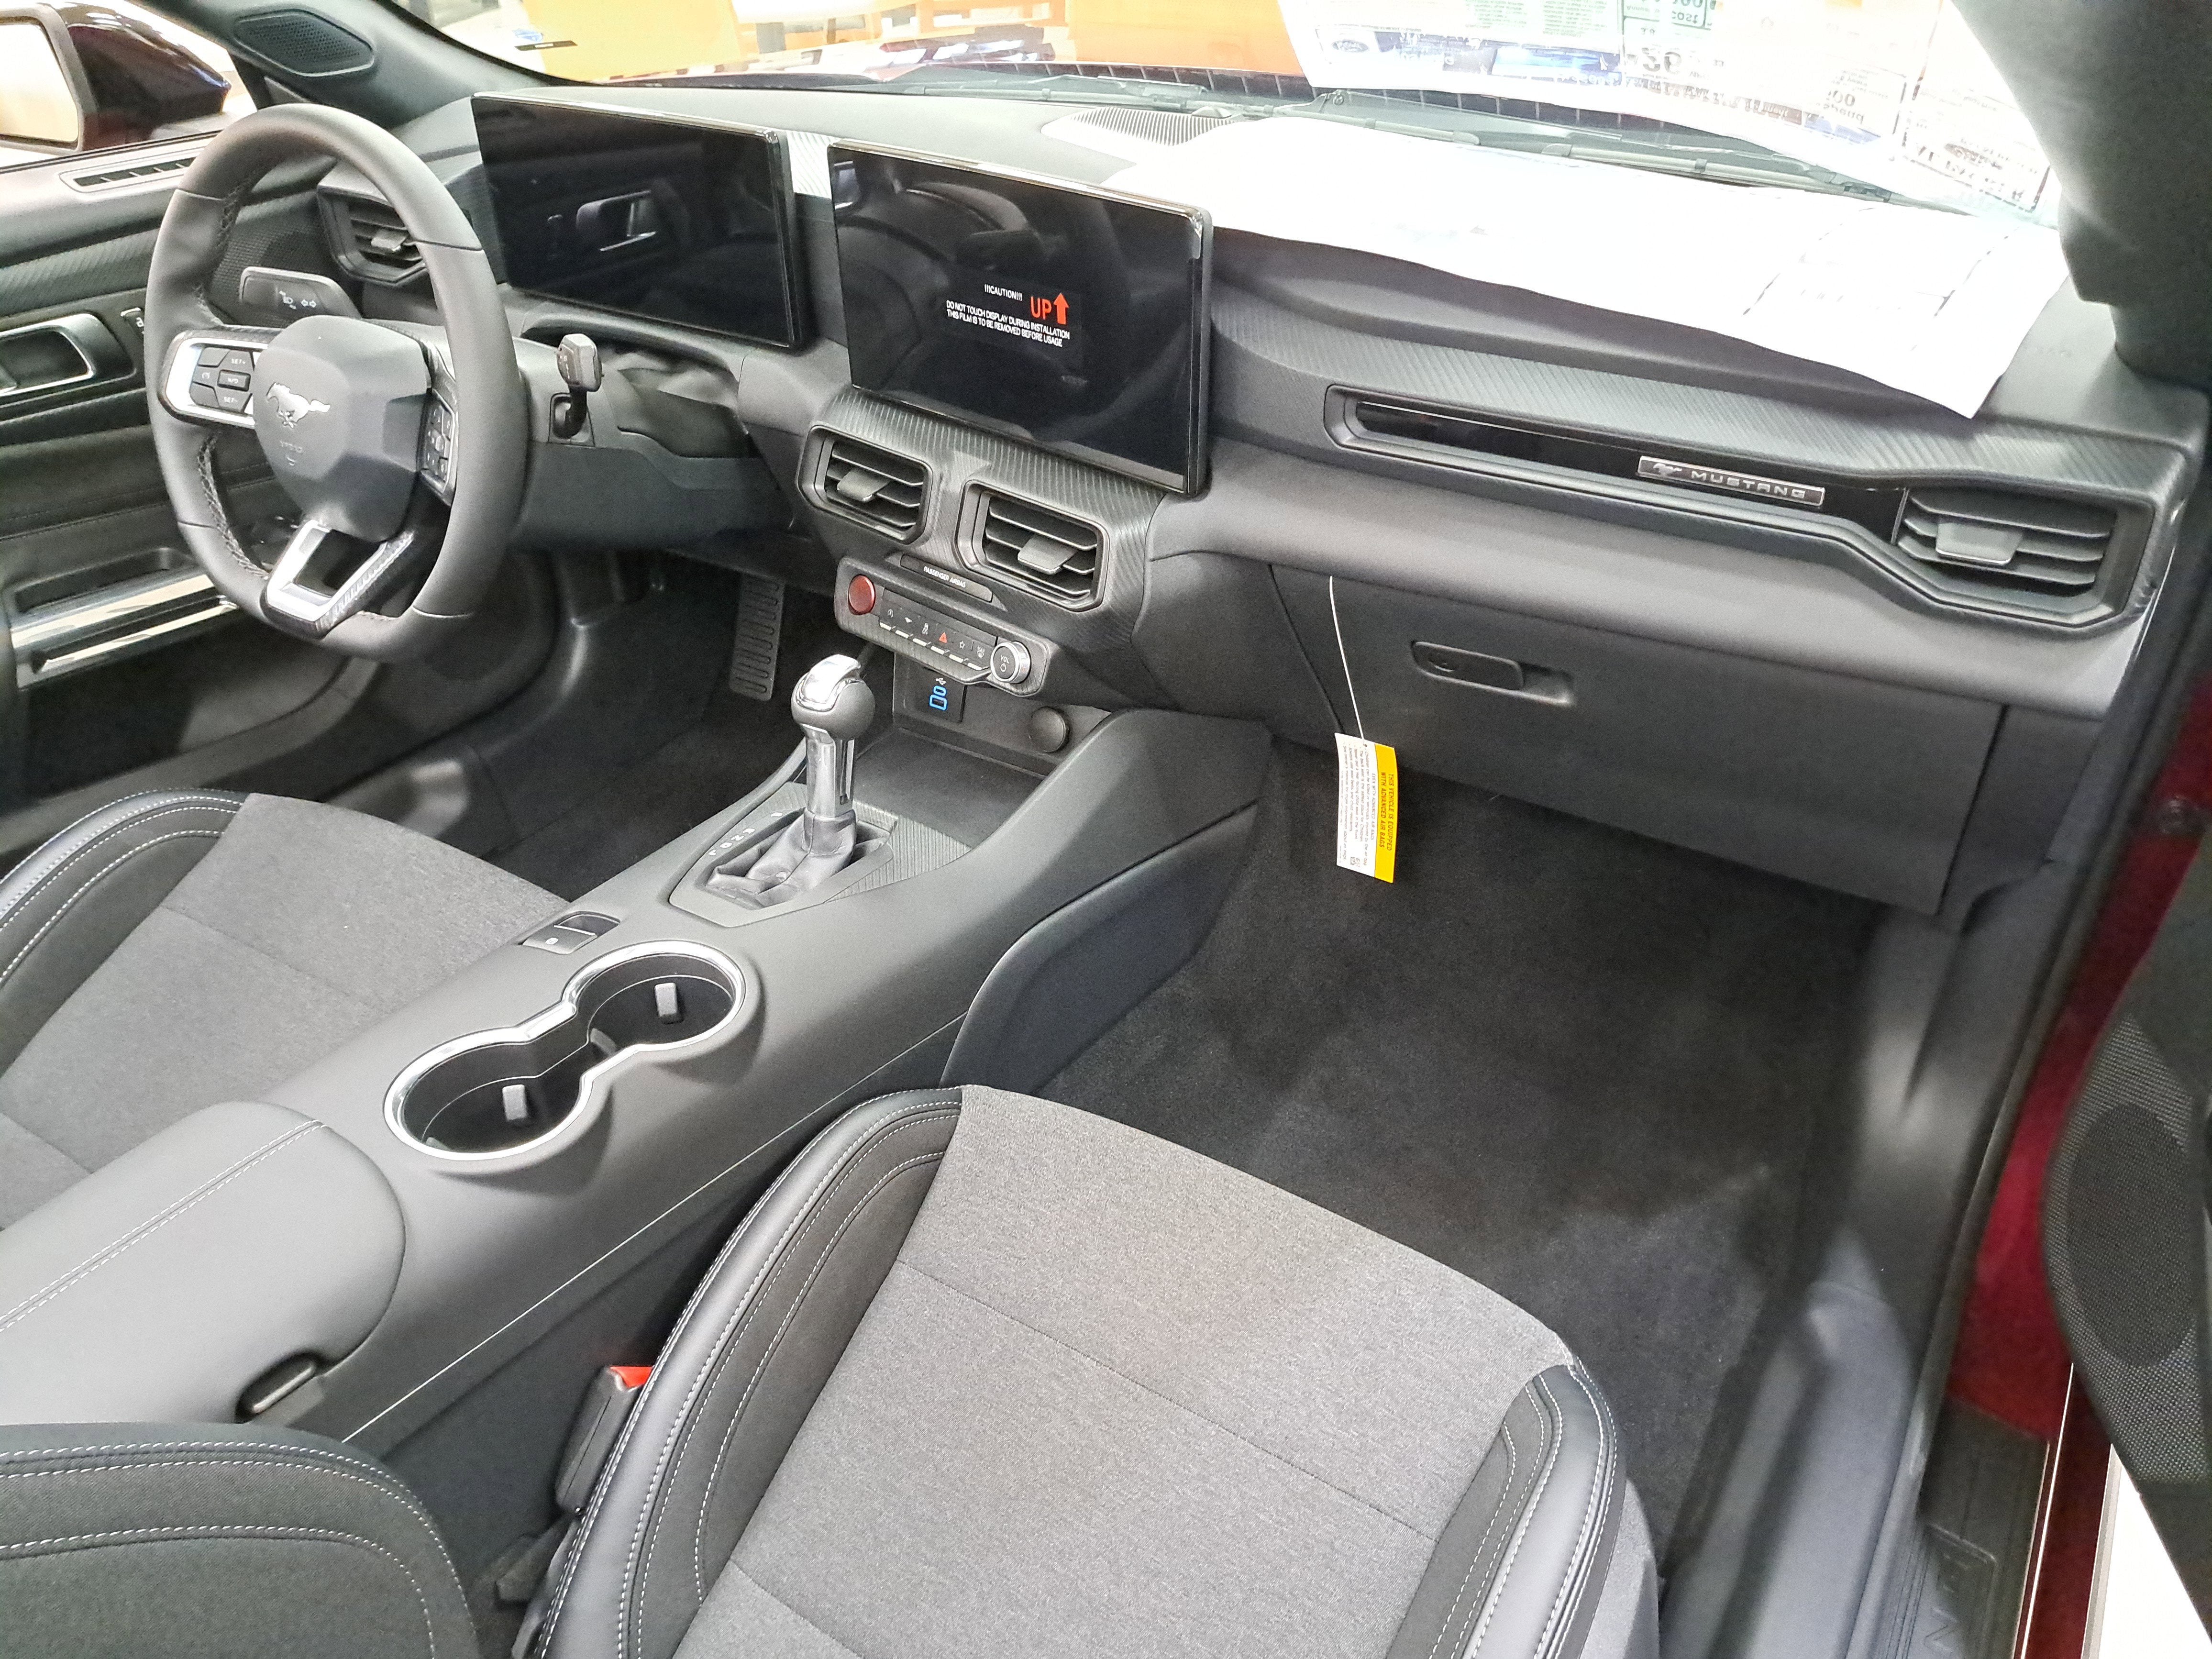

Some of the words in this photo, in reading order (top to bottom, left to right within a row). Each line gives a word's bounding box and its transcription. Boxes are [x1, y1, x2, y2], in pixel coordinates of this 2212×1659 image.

[946, 300, 954, 310] DO
[955, 302, 966, 312] NOT
[966, 305, 985, 318] TOUCH
[986, 310, 1008, 323] DISPLAY
[1008, 316, 1030, 330] DURING
[1030, 321, 1070, 340] INSTALLATION
[1030, 296, 1052, 320] UP
[947, 309, 959, 320] THIS
[959, 312, 972, 323] FILM
[972, 316, 978, 324] IS
[978, 317, 986, 327] TO
[986, 319, 994, 329] BE
[994, 321, 1021, 336] REMOVED
[1021, 328, 1043, 343] BEFORE
[1691, 470, 1806, 498] MUSTANG
[923, 566, 950, 581] PASSENGER
[949, 577, 966, 588] AIRBAG
[1000, 654, 1010, 664] VOL
